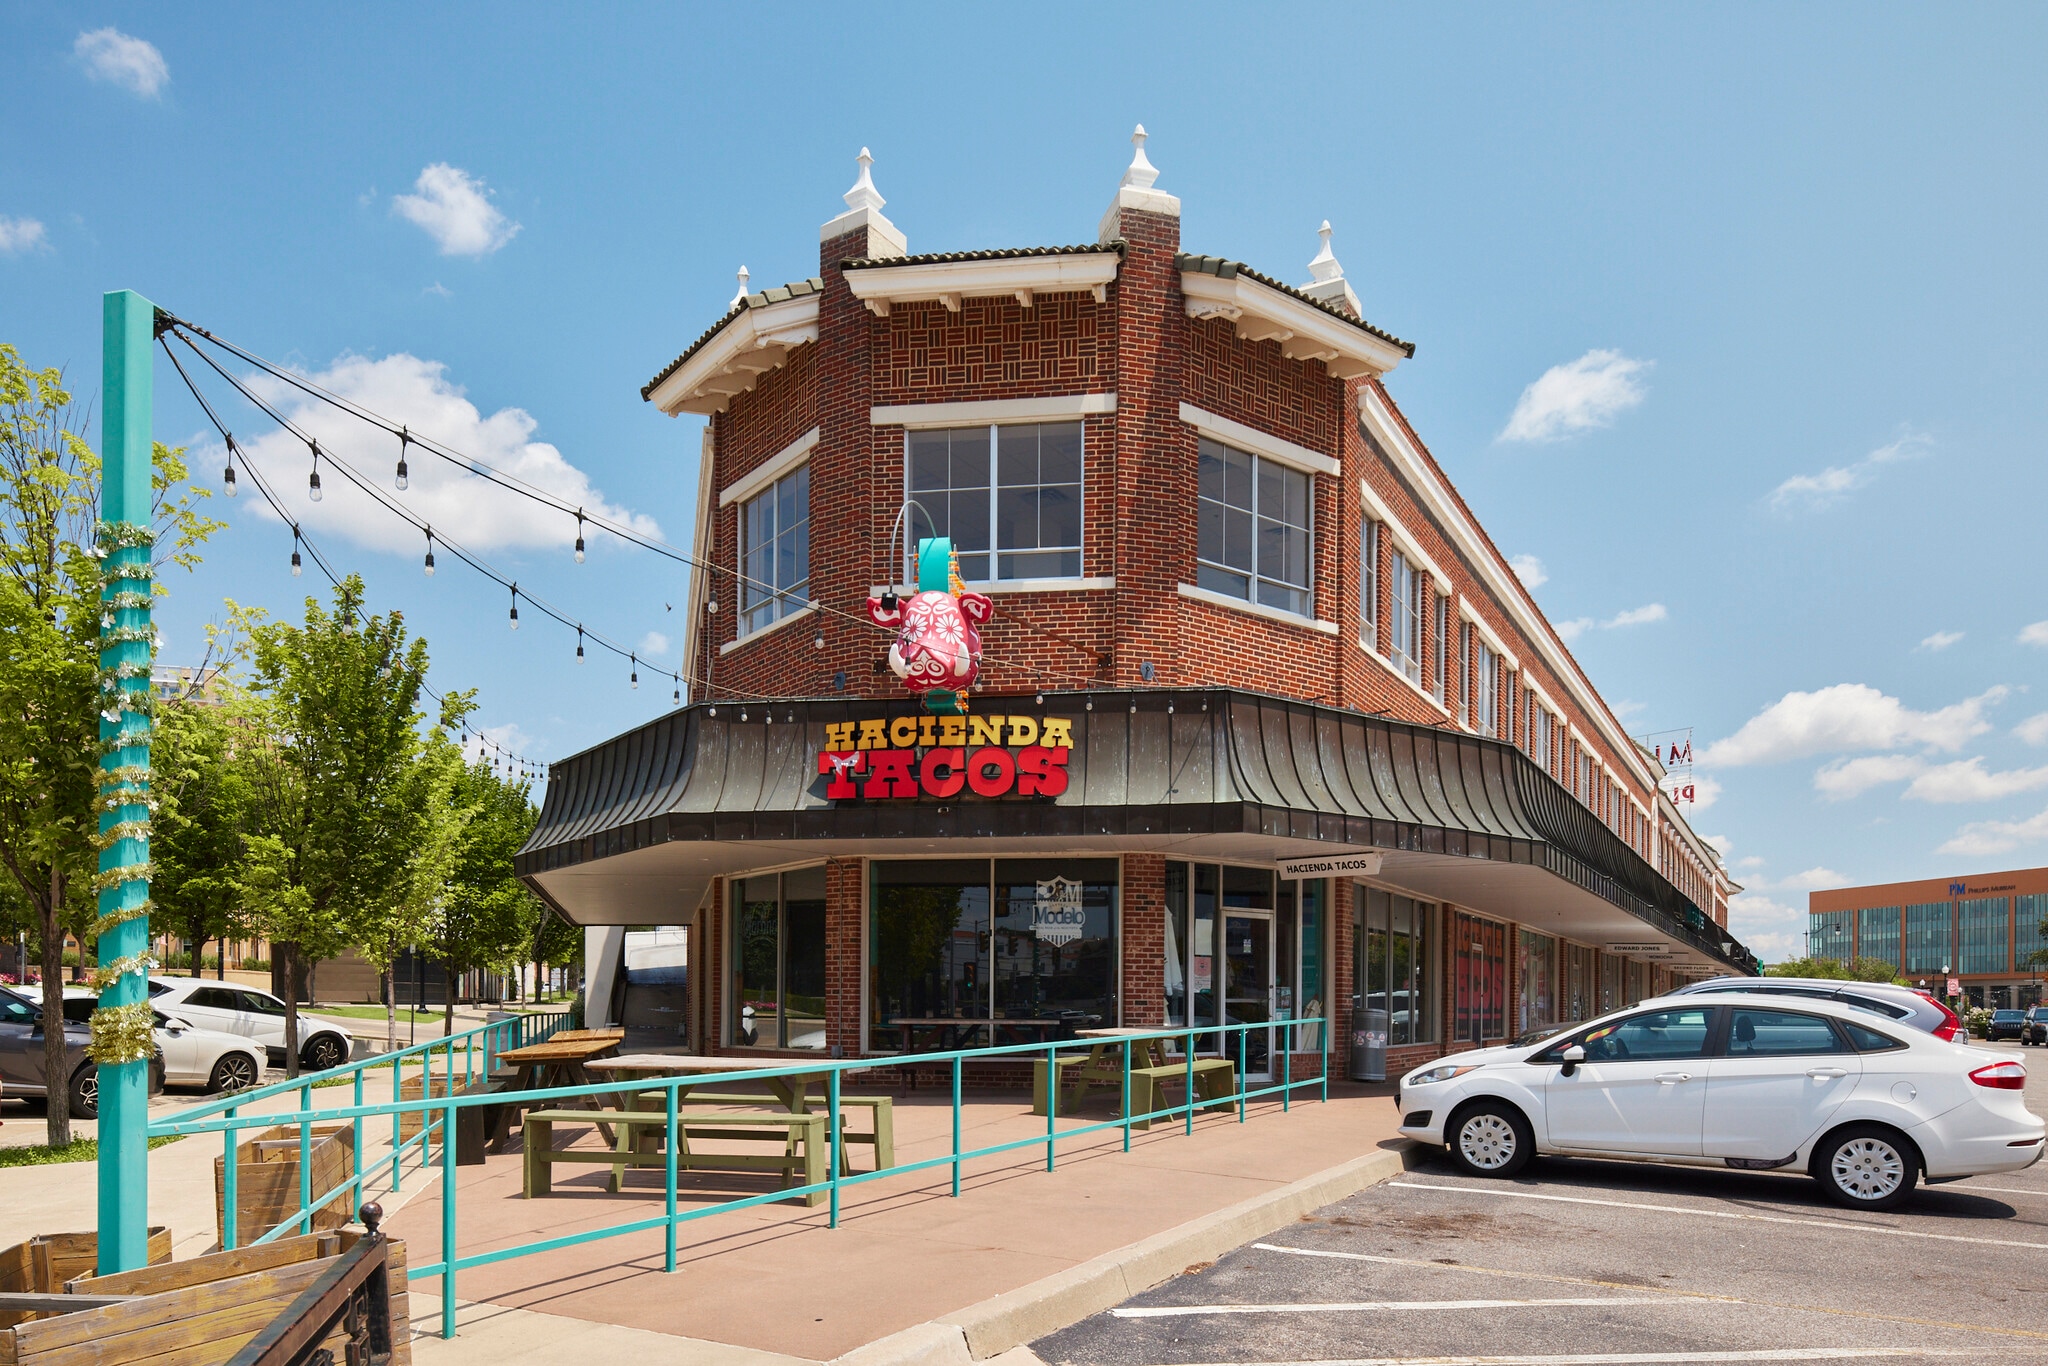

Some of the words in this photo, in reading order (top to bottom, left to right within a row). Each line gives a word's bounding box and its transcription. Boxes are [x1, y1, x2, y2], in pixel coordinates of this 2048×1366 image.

[824, 715, 1074, 751] HACIENDA
[818, 745, 1069, 799] TACOS
[1286, 862, 1333, 874] HACIENDA
[1335, 860, 1367, 870] TACOS
[1034, 906, 1085, 924] Modelo
